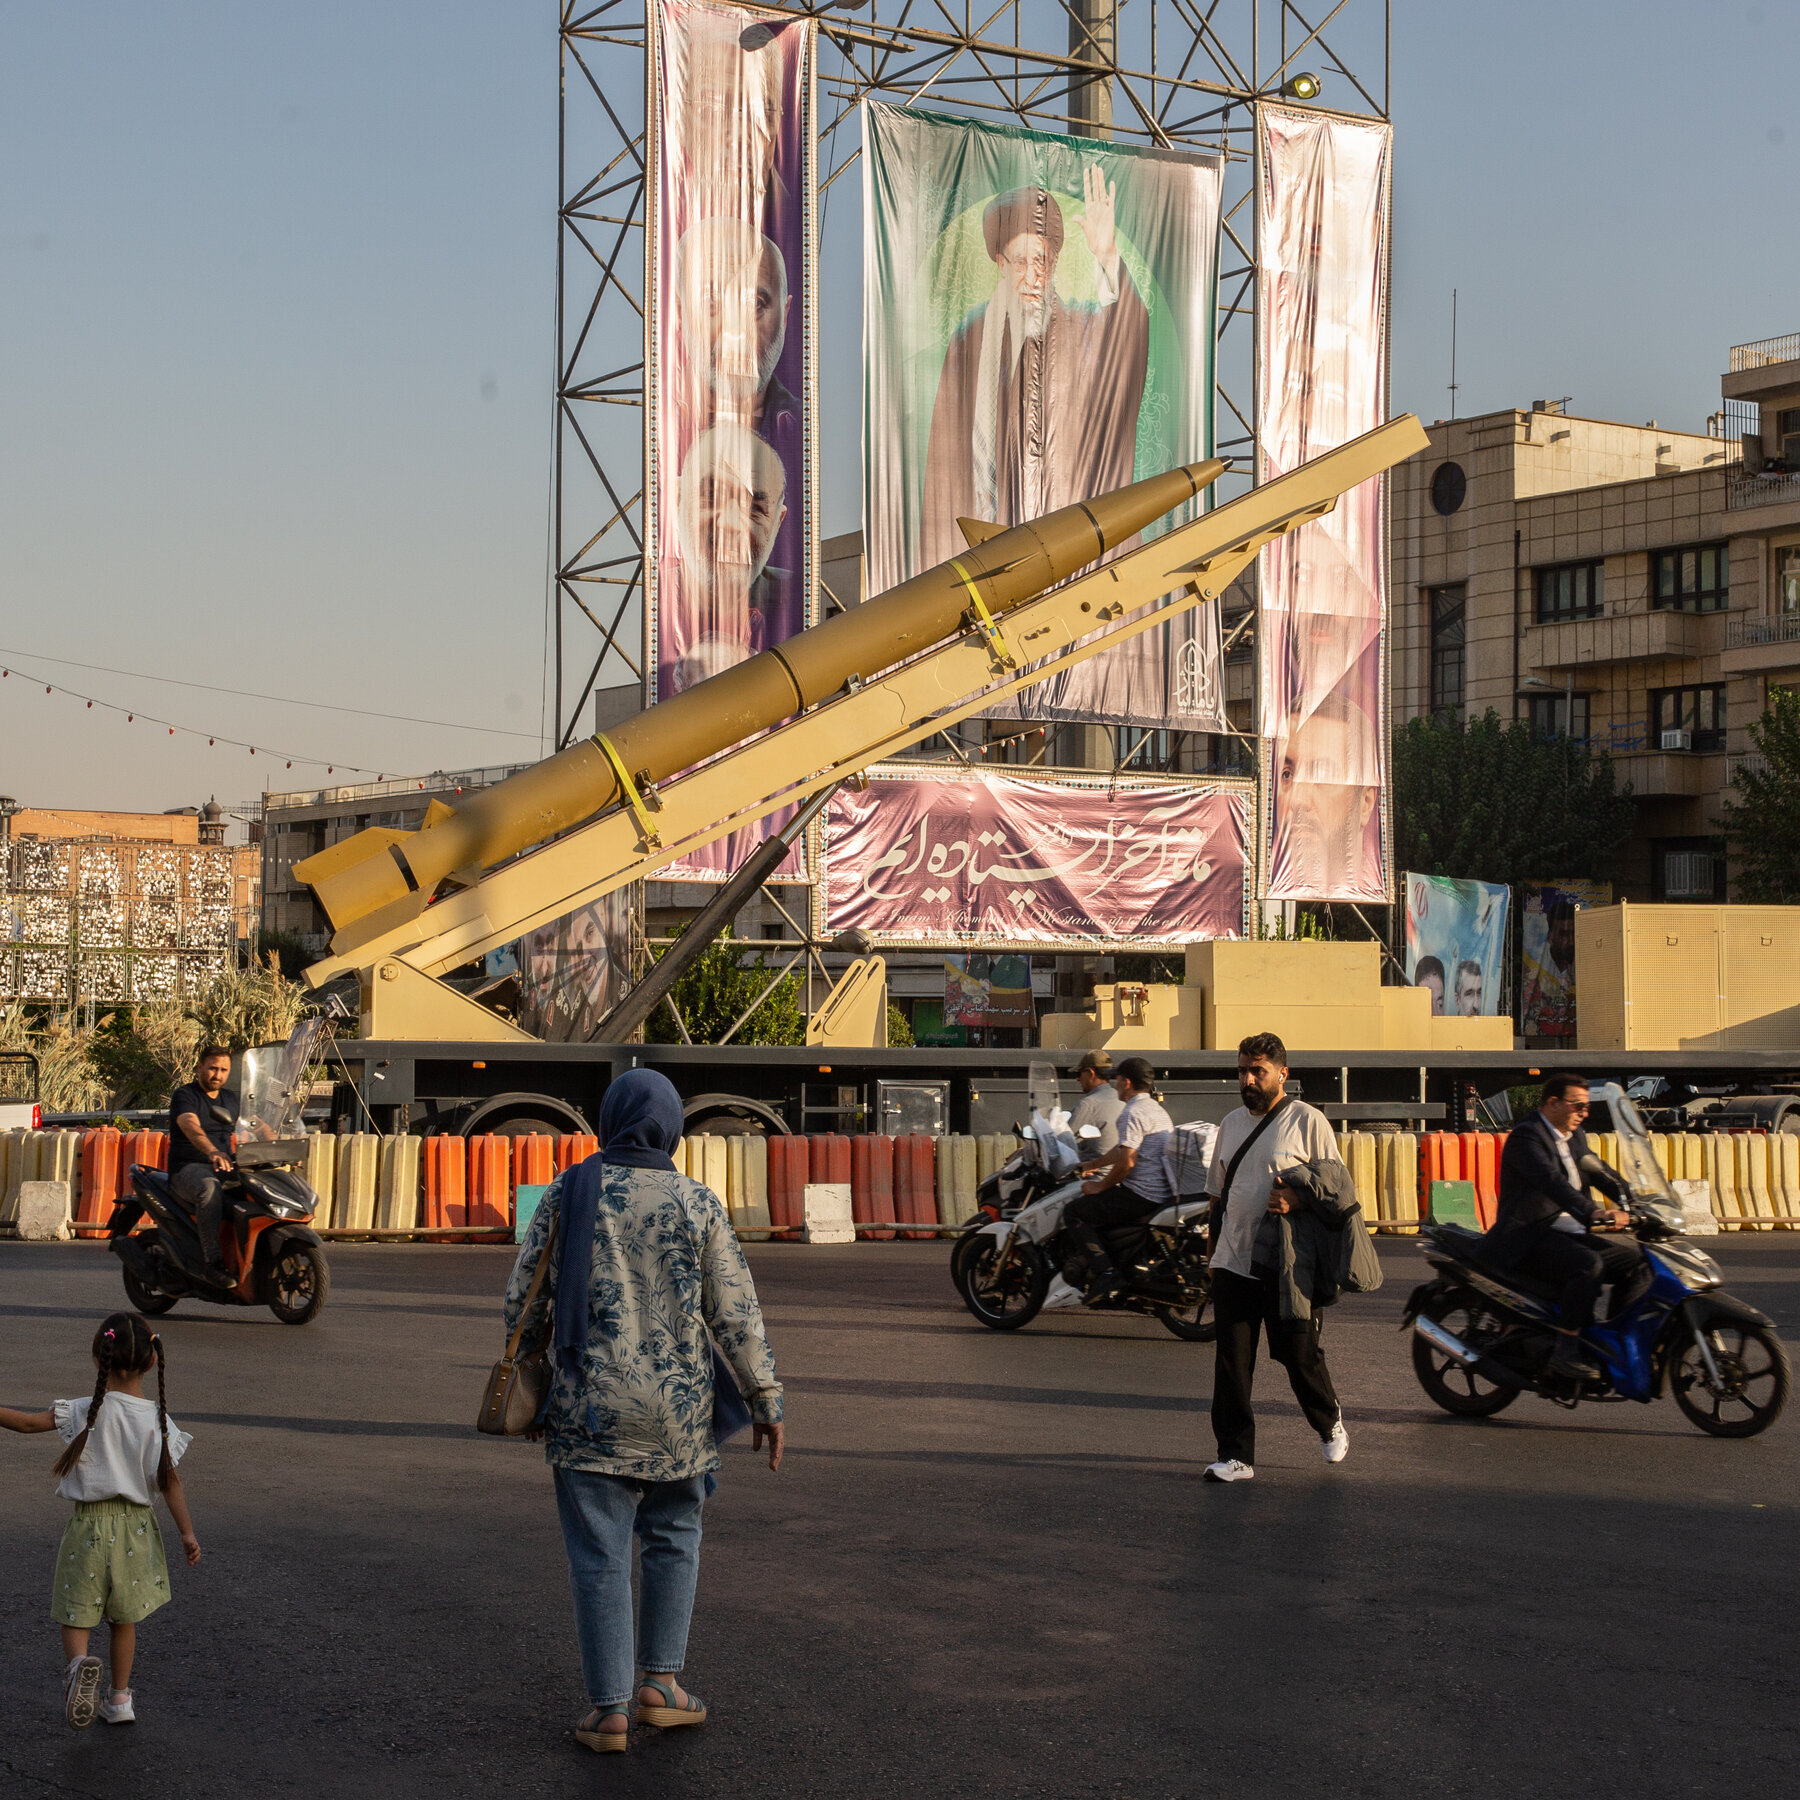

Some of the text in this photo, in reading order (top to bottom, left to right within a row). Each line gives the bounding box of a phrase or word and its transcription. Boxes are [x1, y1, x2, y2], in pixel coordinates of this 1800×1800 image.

[926, 819, 1114, 906] ایستاده
[1083, 797, 1191, 900] آخر
[1192, 848, 1211, 882] ما
[881, 907, 930, 923] Imam
[1030, 906, 1072, 925] We
[1107, 915, 1123, 931] up
[1141, 913, 1160, 926] the
